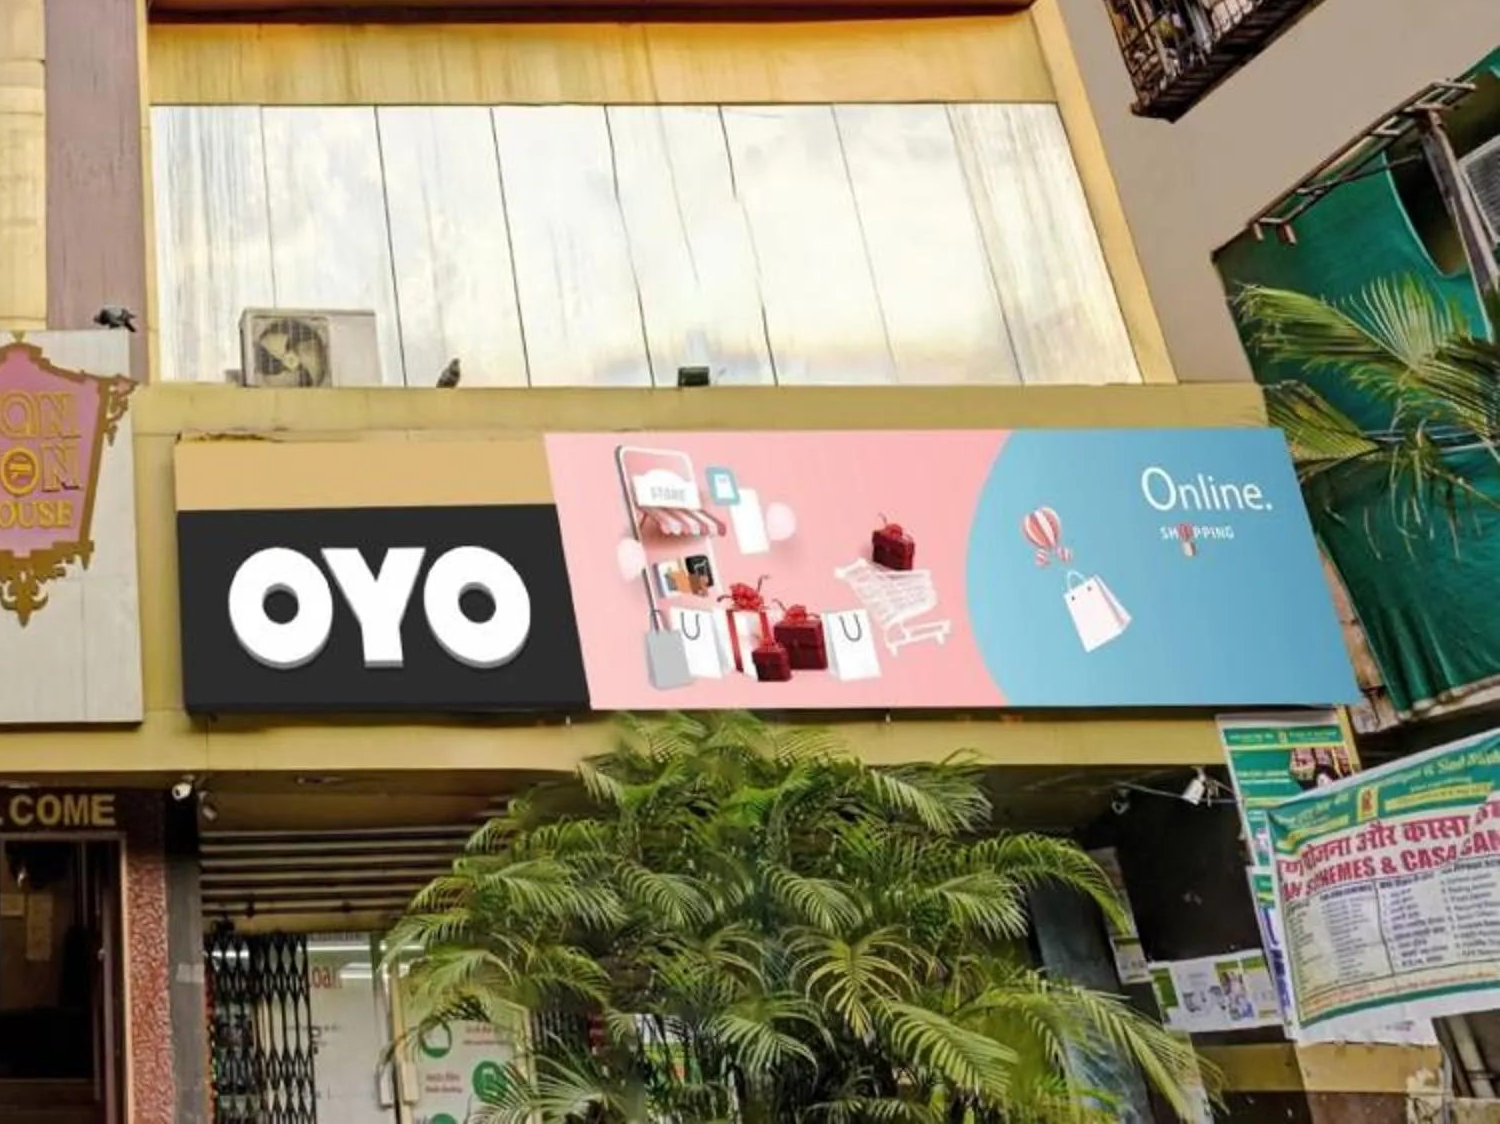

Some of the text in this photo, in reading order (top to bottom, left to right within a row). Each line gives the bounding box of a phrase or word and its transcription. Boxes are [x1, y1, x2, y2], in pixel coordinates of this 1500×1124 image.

[1141, 465, 1274, 512] Online.
[1159, 525, 1236, 541] SHPPING
[228, 545, 532, 669] OYO
[1380, 856, 1398, 875] &
